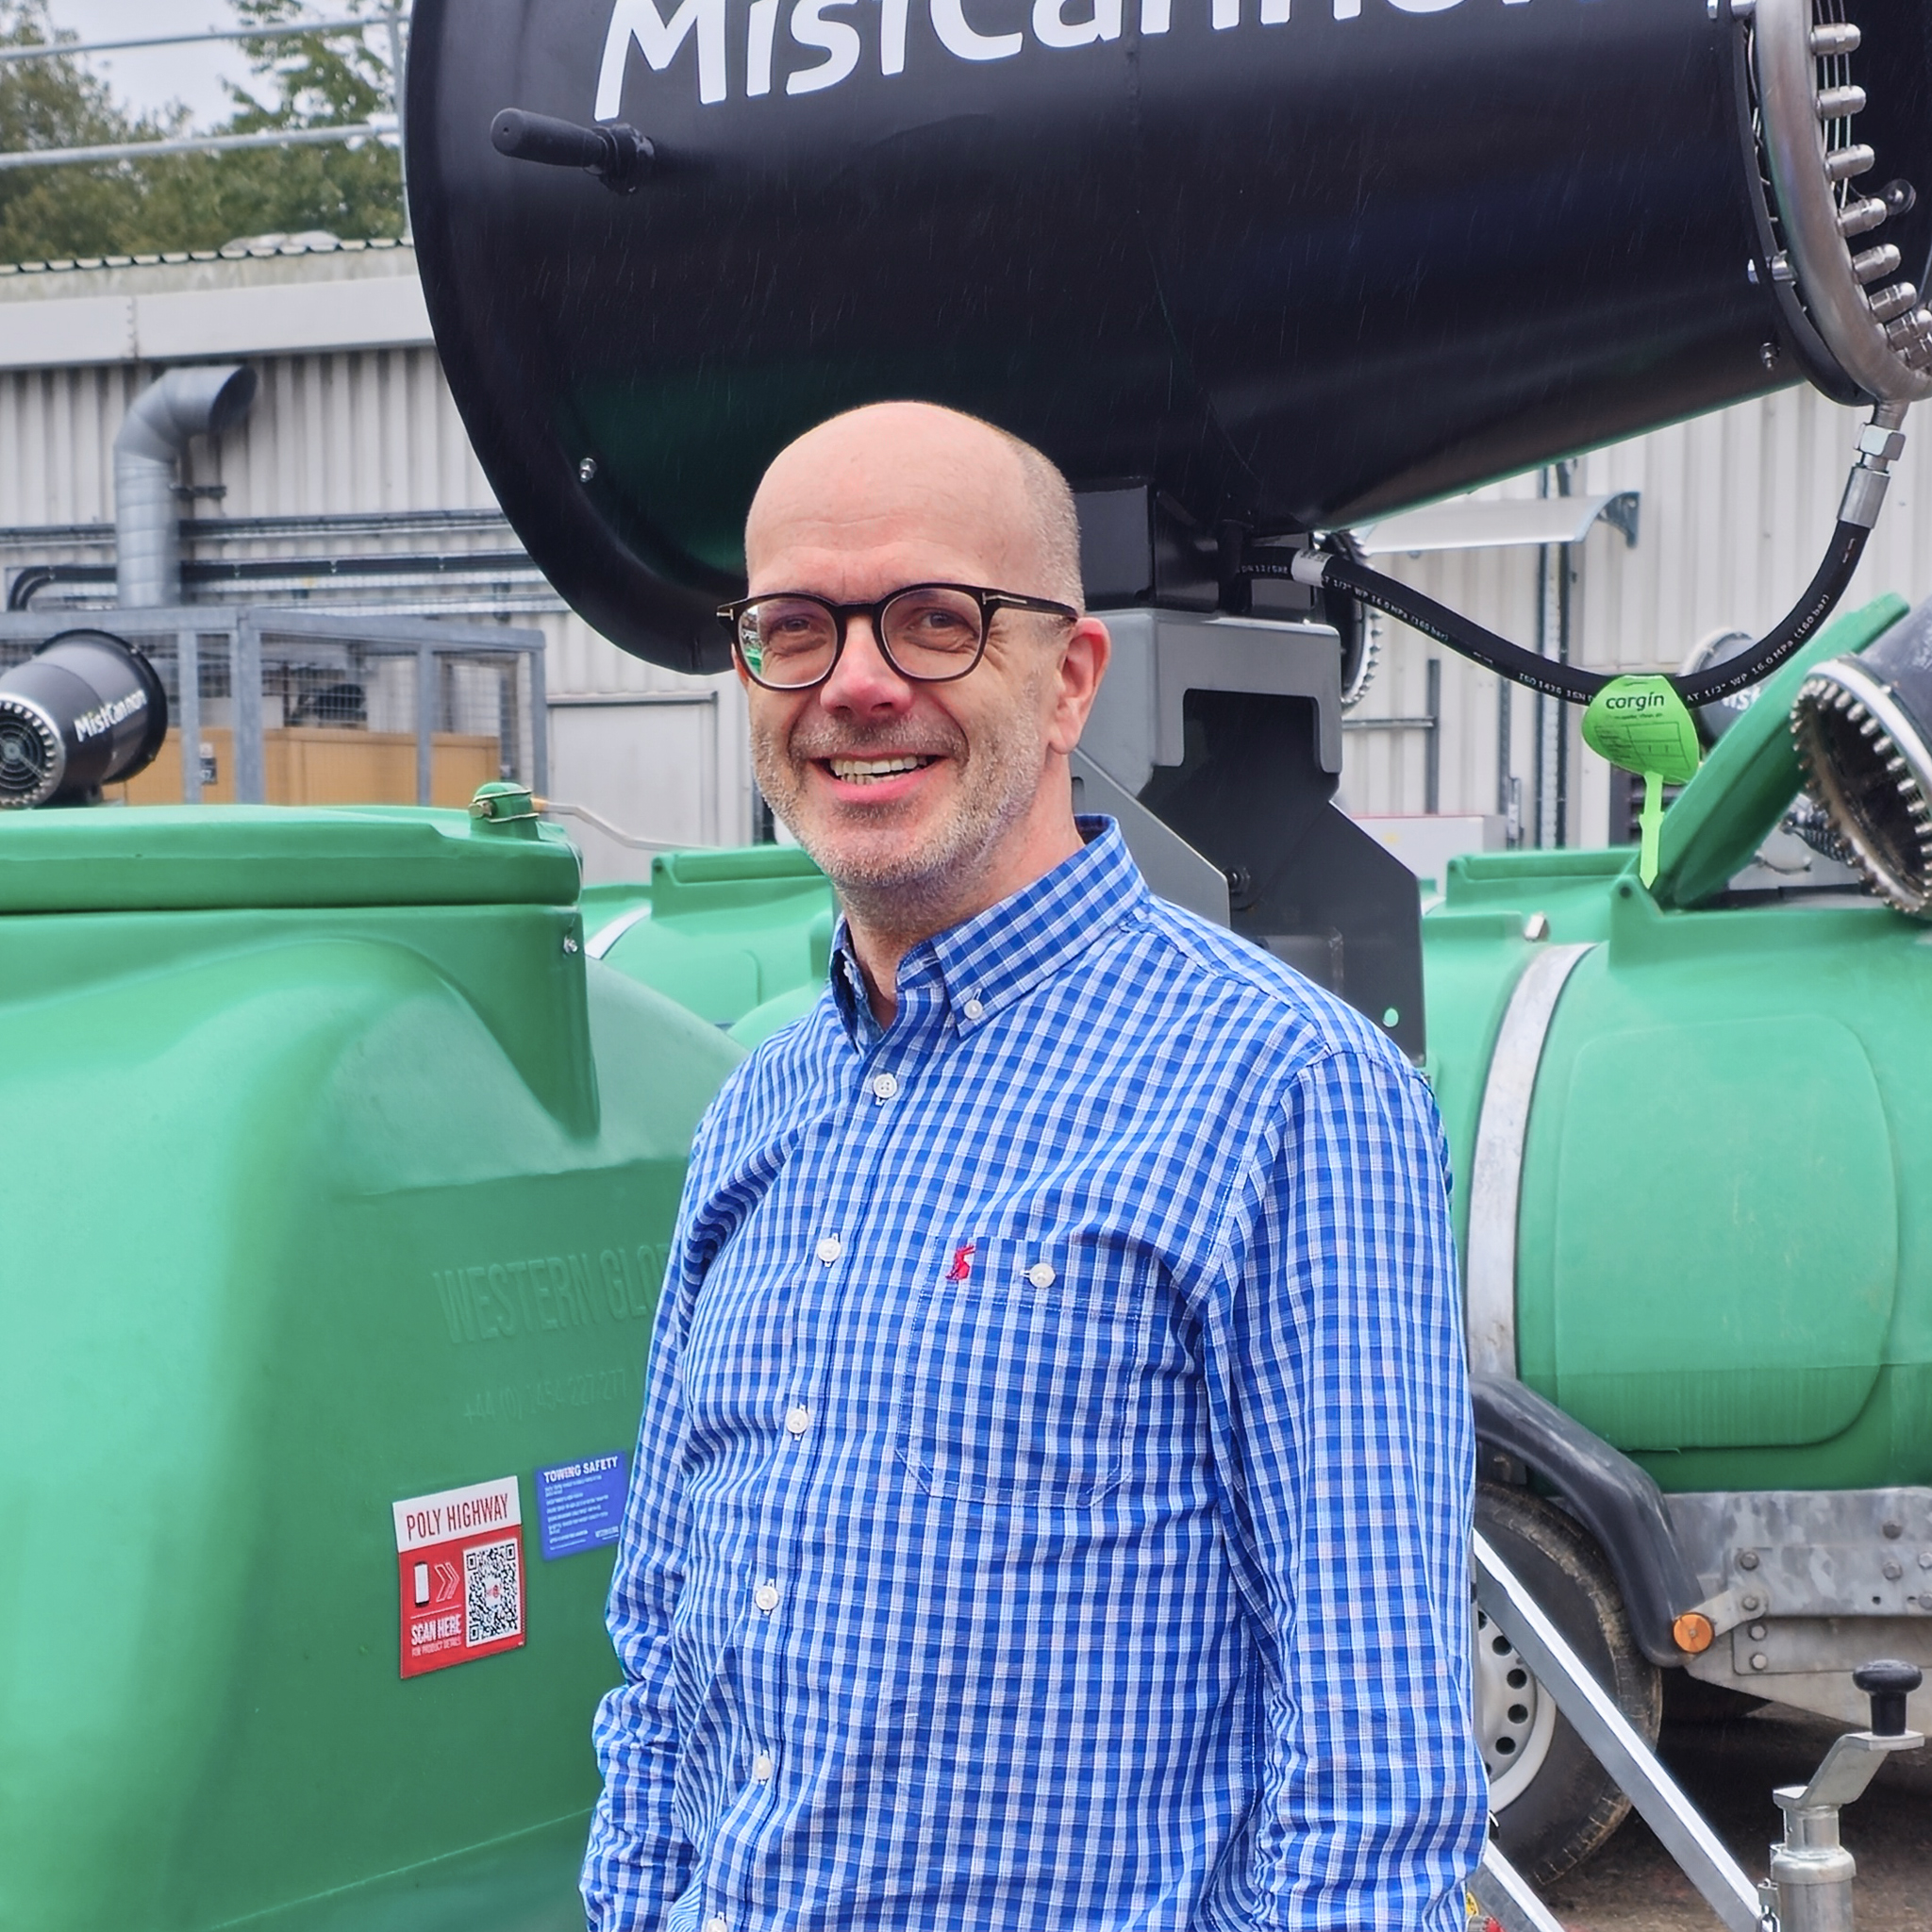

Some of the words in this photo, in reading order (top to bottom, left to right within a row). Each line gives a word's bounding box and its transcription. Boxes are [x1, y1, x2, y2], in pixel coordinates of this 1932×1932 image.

[1729, 673, 1748, 687] WP
[1751, 657, 1774, 675] 16.0
[1773, 640, 1793, 658] MPa
[1812, 593, 1830, 617] bar)
[1519, 673, 1536, 686] ISO
[74, 690, 147, 742] MistCannon
[432, 1253, 597, 1344] WESTERN
[543, 1465, 581, 1484] TOWING
[583, 1456, 618, 1474] SAFETY
[407, 1507, 441, 1541] POLY
[446, 1492, 508, 1532] HIGHWAY
[411, 1621, 437, 1645] SCAN
[437, 1614, 461, 1639] HERE
